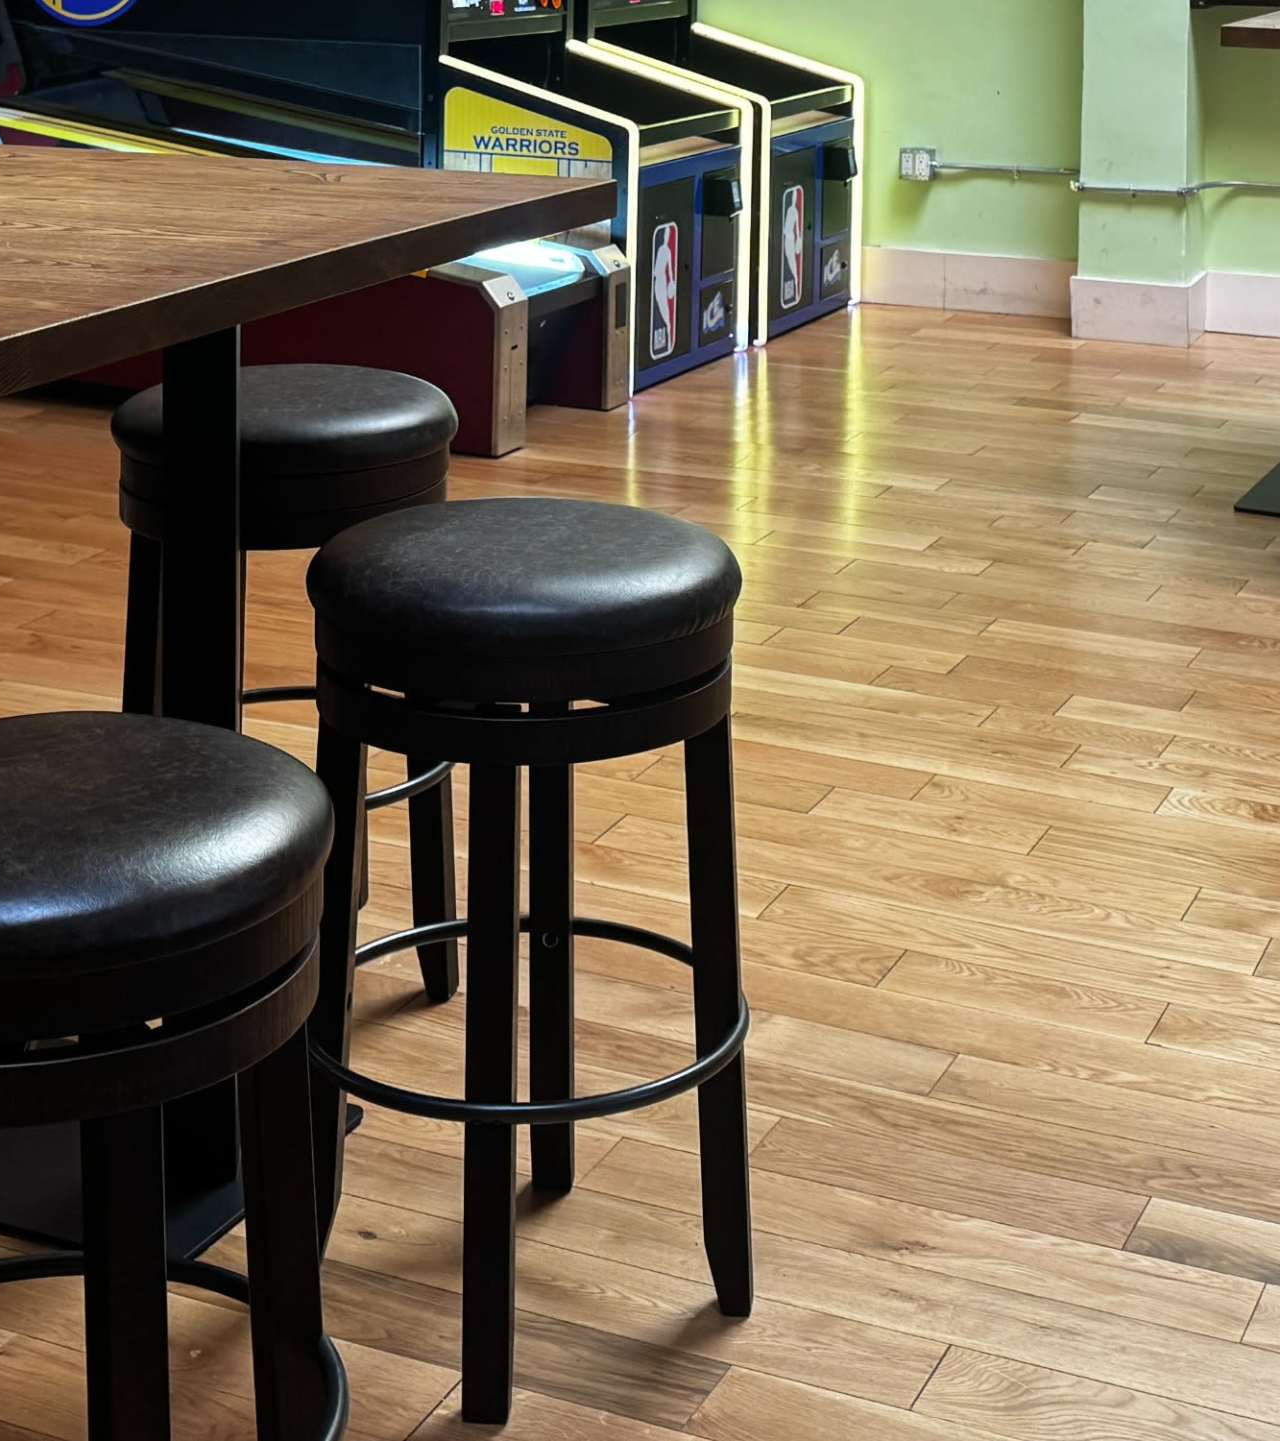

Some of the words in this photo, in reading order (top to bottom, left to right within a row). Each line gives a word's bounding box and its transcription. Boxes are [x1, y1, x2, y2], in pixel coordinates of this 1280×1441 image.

[491, 126, 534, 137] GOLDEN
[536, 128, 567, 139] STATE
[473, 135, 580, 156] WARRIORS
